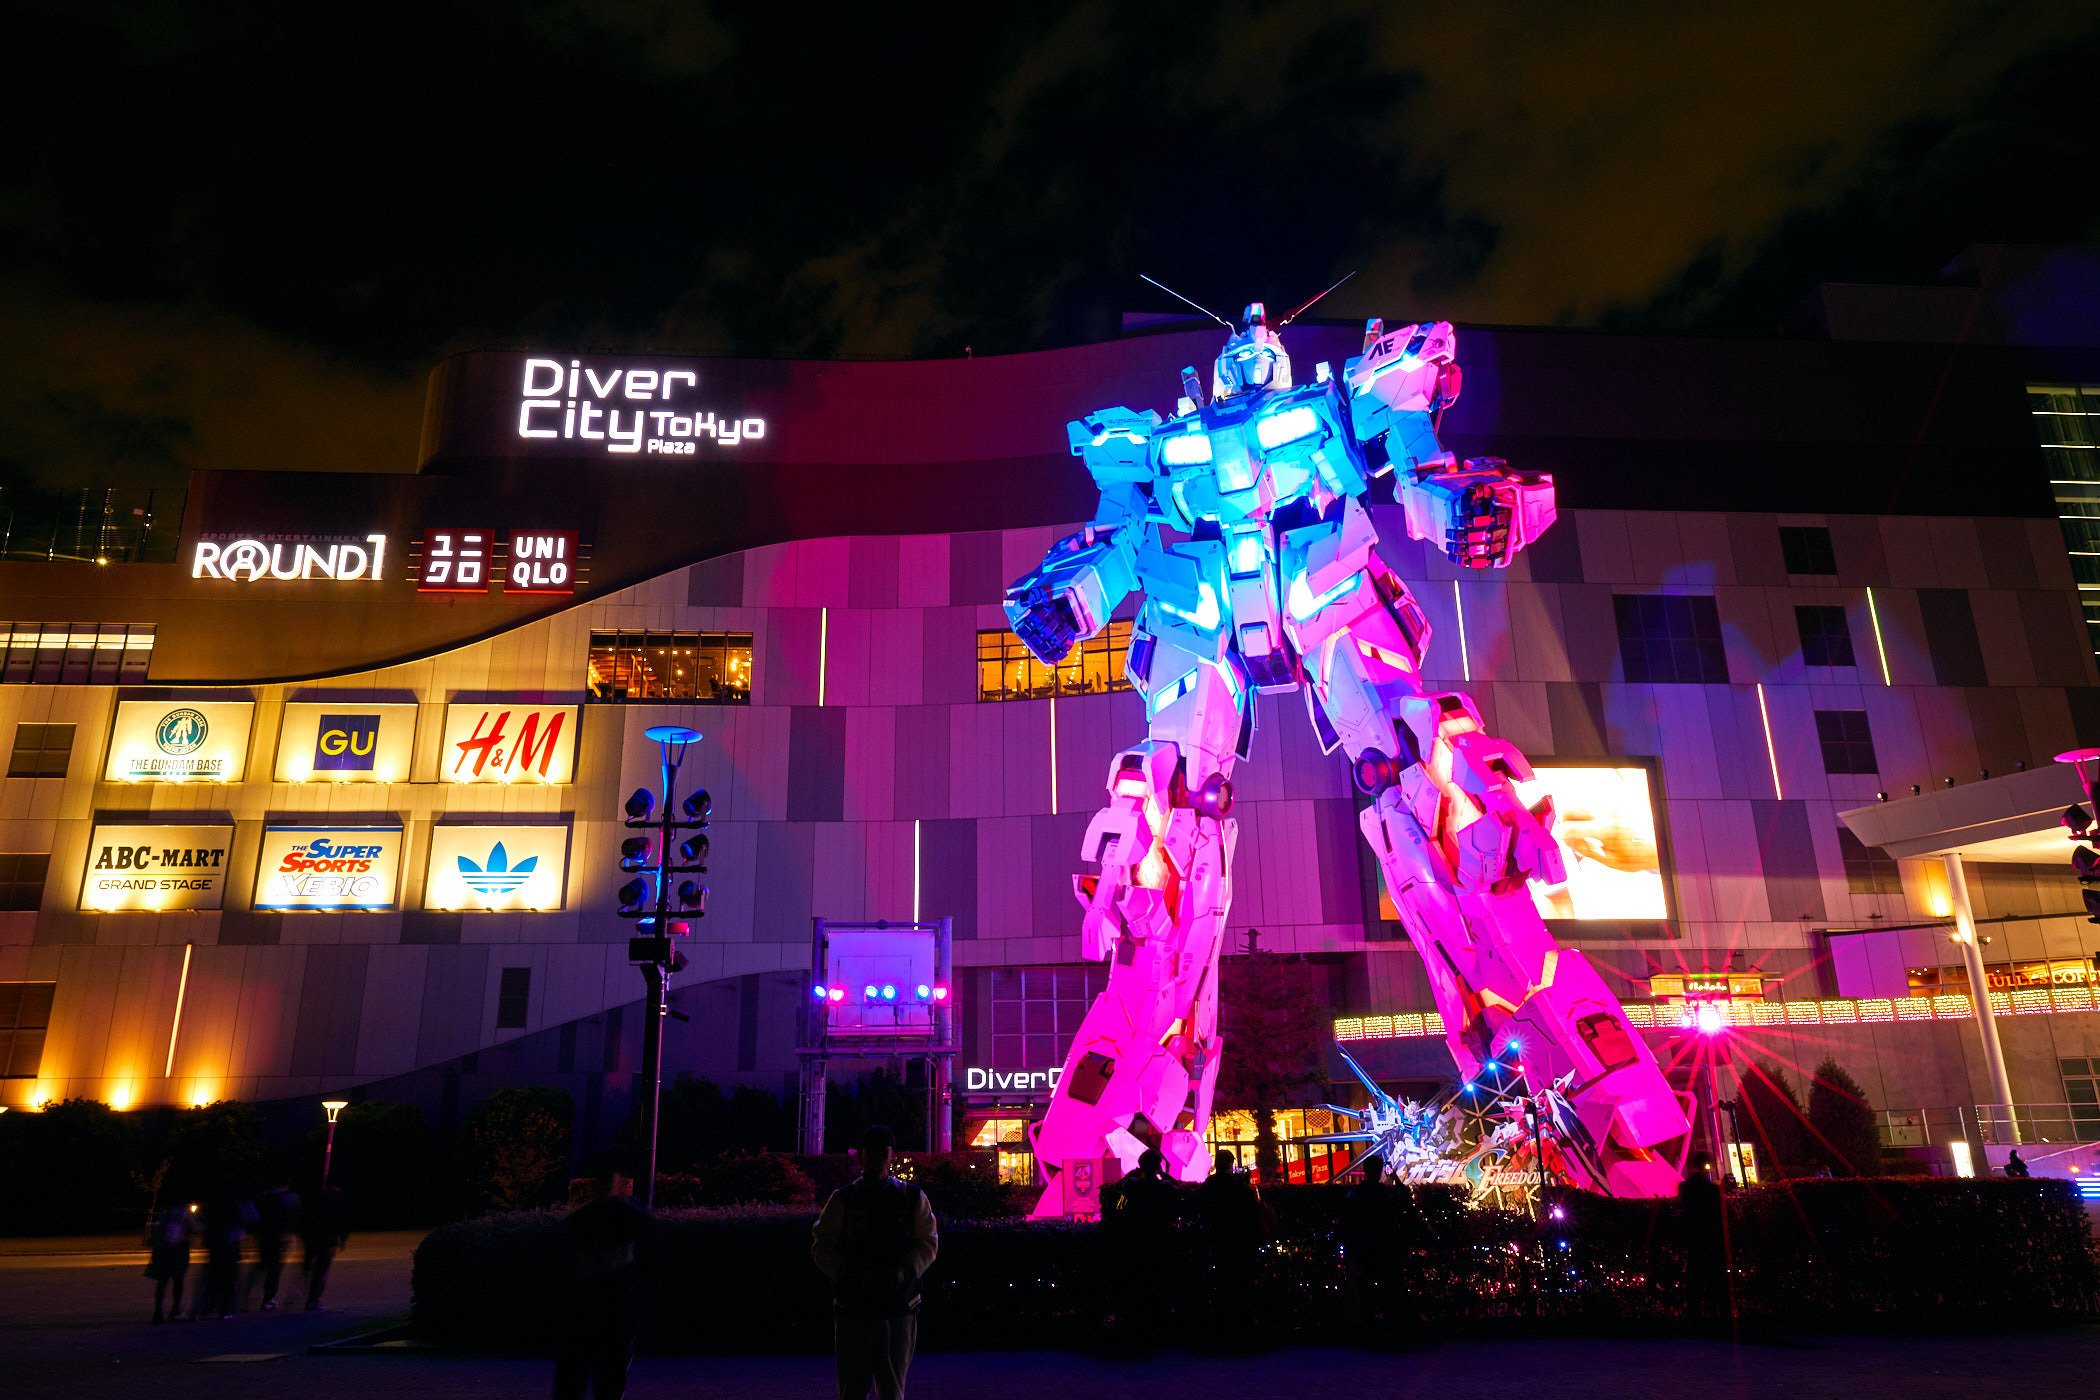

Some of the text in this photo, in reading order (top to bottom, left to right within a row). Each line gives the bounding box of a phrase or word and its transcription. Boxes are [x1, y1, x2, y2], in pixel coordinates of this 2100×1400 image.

[522, 358, 696, 400] Diver
[518, 399, 766, 454] City Tokyo
[647, 438, 696, 455] Plaza
[256, 533, 363, 543] ENTERTAINMEN
[431, 535, 482, 557] ユニ
[515, 536, 565, 559] UNI
[191, 533, 387, 582] ROUND1
[425, 560, 481, 583] クロ
[512, 561, 568, 588] QLO
[319, 729, 375, 756] GU
[454, 711, 566, 778] H&M
[130, 758, 223, 771] THE GUNDAM BASE
[94, 846, 224, 870] ABC-MART
[305, 838, 383, 859] SUPER
[278, 852, 372, 873] SPORTS
[98, 879, 213, 891] GRAND STAGE
[278, 873, 379, 898] XEBIO
